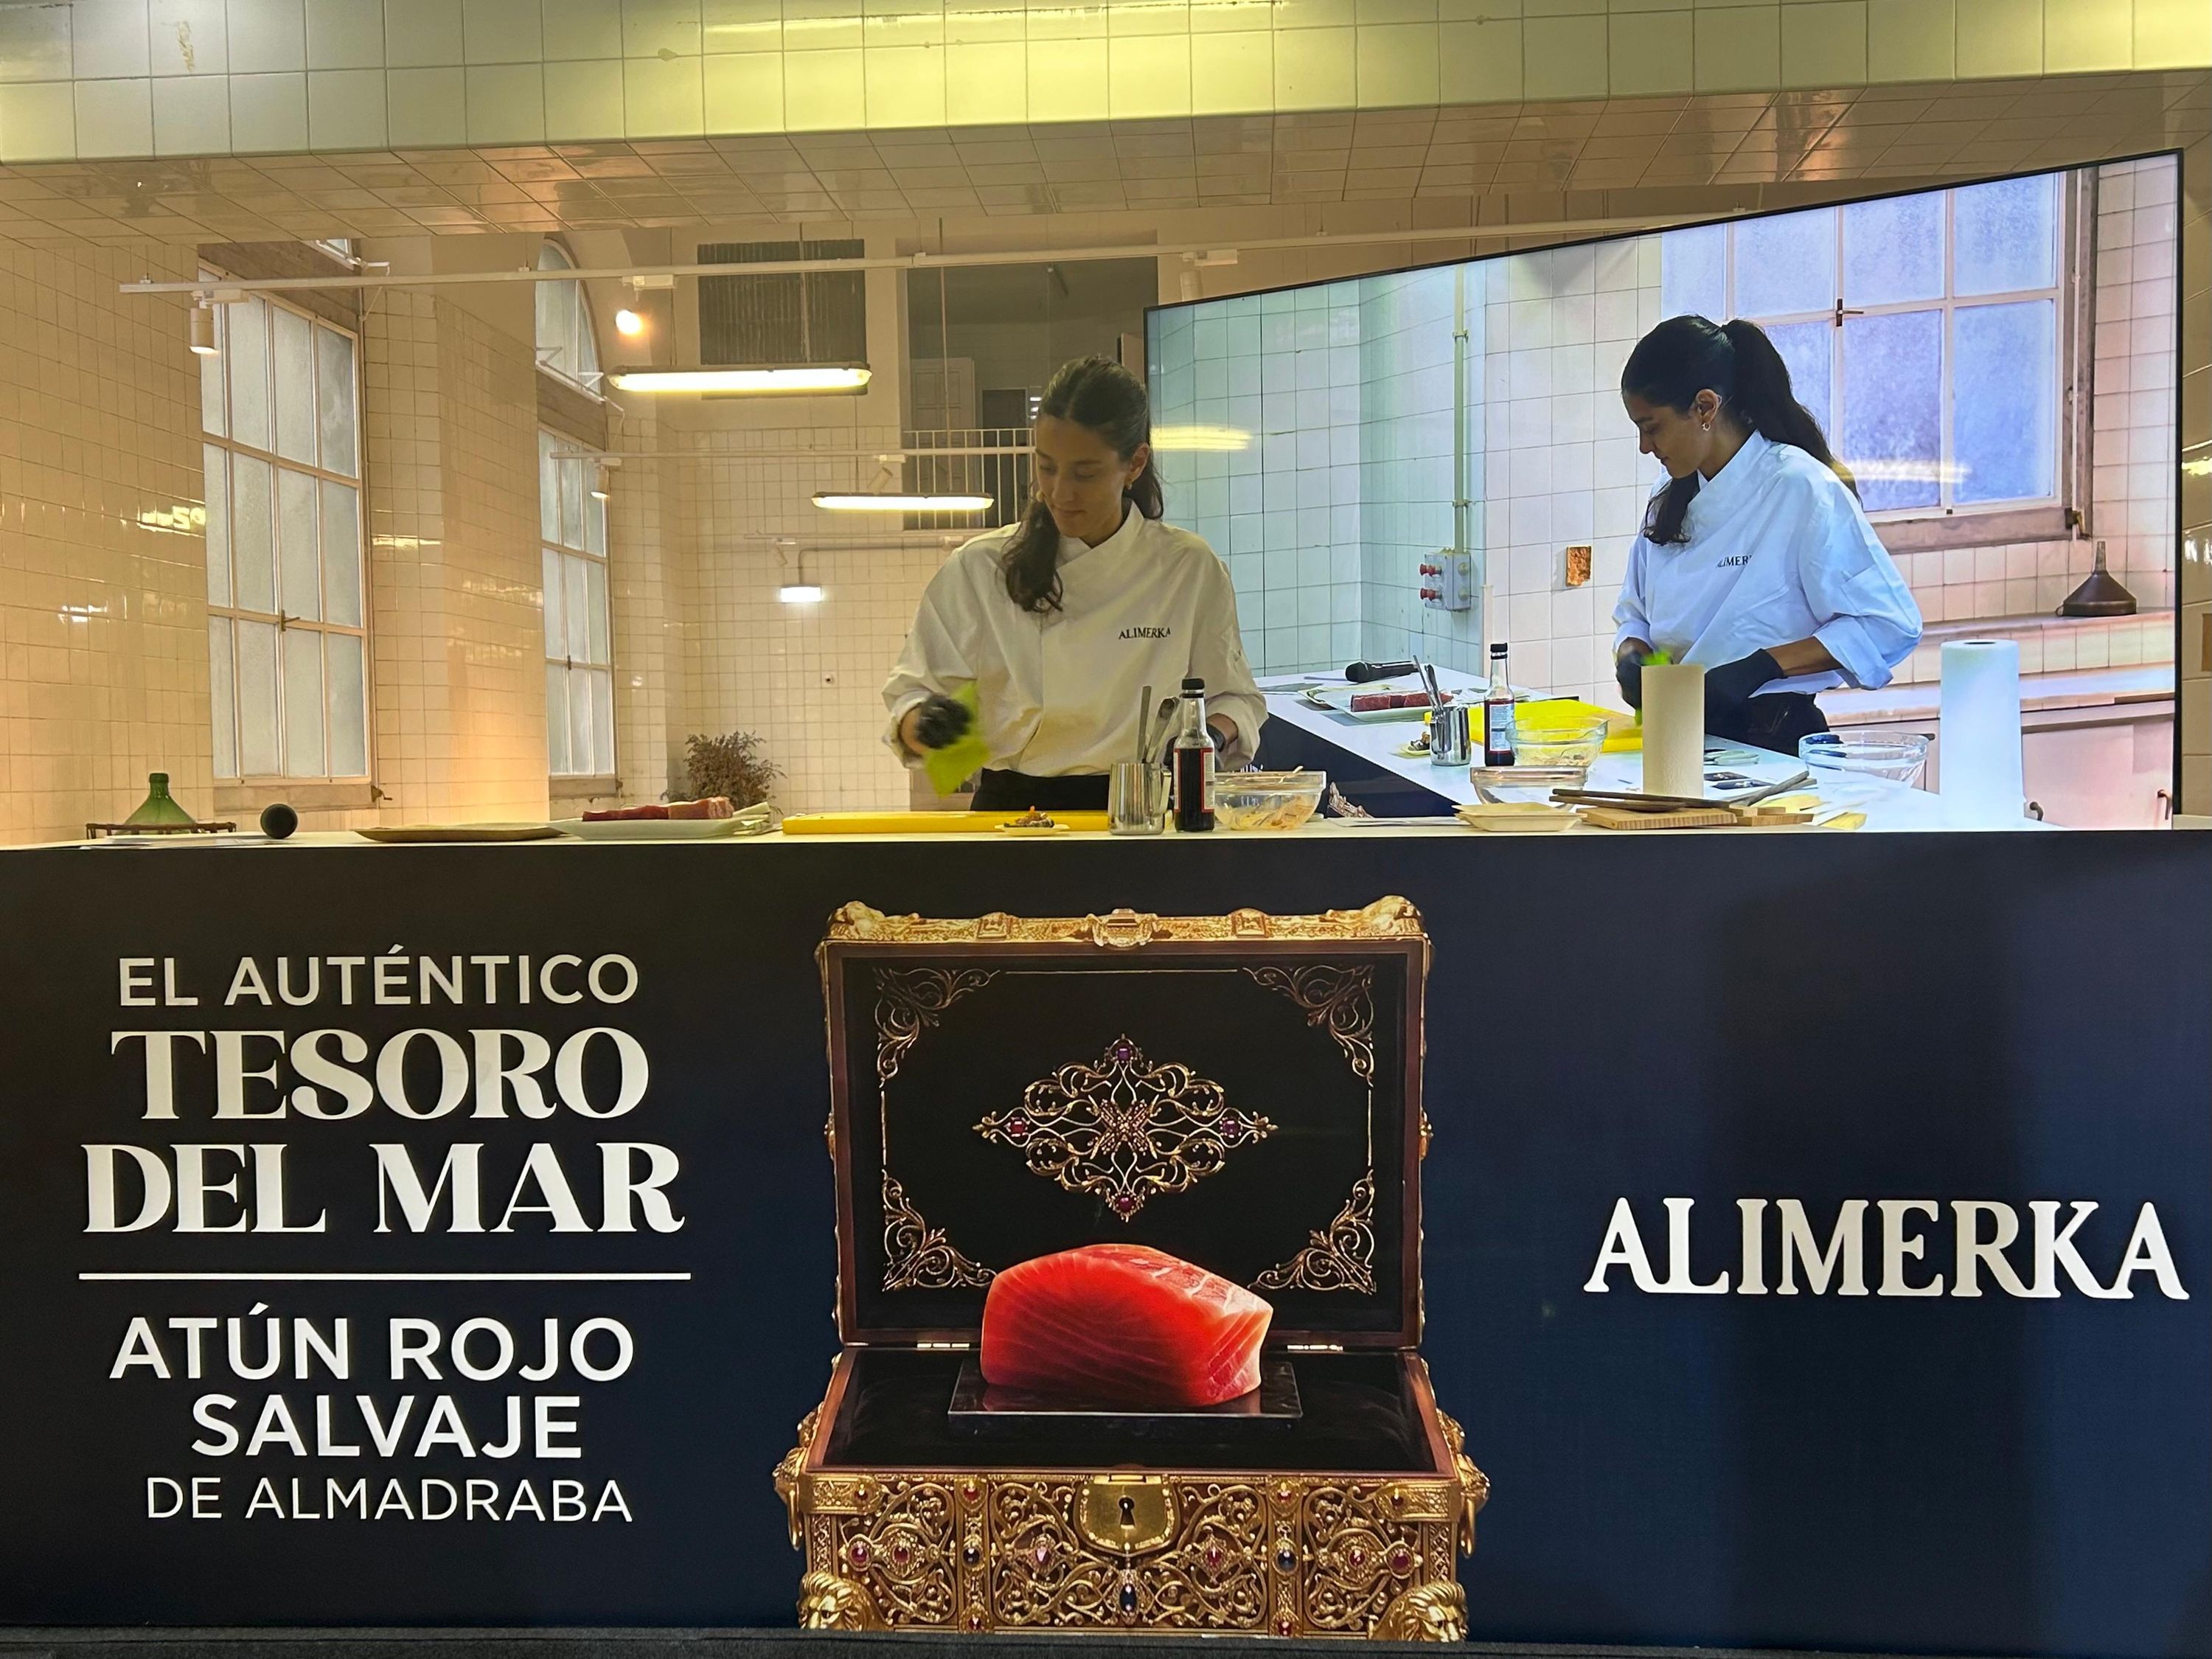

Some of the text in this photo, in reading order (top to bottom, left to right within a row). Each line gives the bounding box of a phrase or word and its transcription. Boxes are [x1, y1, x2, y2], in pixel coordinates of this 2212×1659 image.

[1119, 627, 1171, 640] ALIMERKA
[119, 944, 639, 1006] EL AUTÉNTICO
[110, 1026, 650, 1120] TESORO
[80, 1142, 686, 1234] DEL MAR
[1583, 1197, 2191, 1301] ALIMERKA
[109, 1301, 635, 1382] ATÚN ROJO
[191, 1393, 582, 1459] SALVAJE
[147, 1477, 633, 1523] DE ALMADRABA
